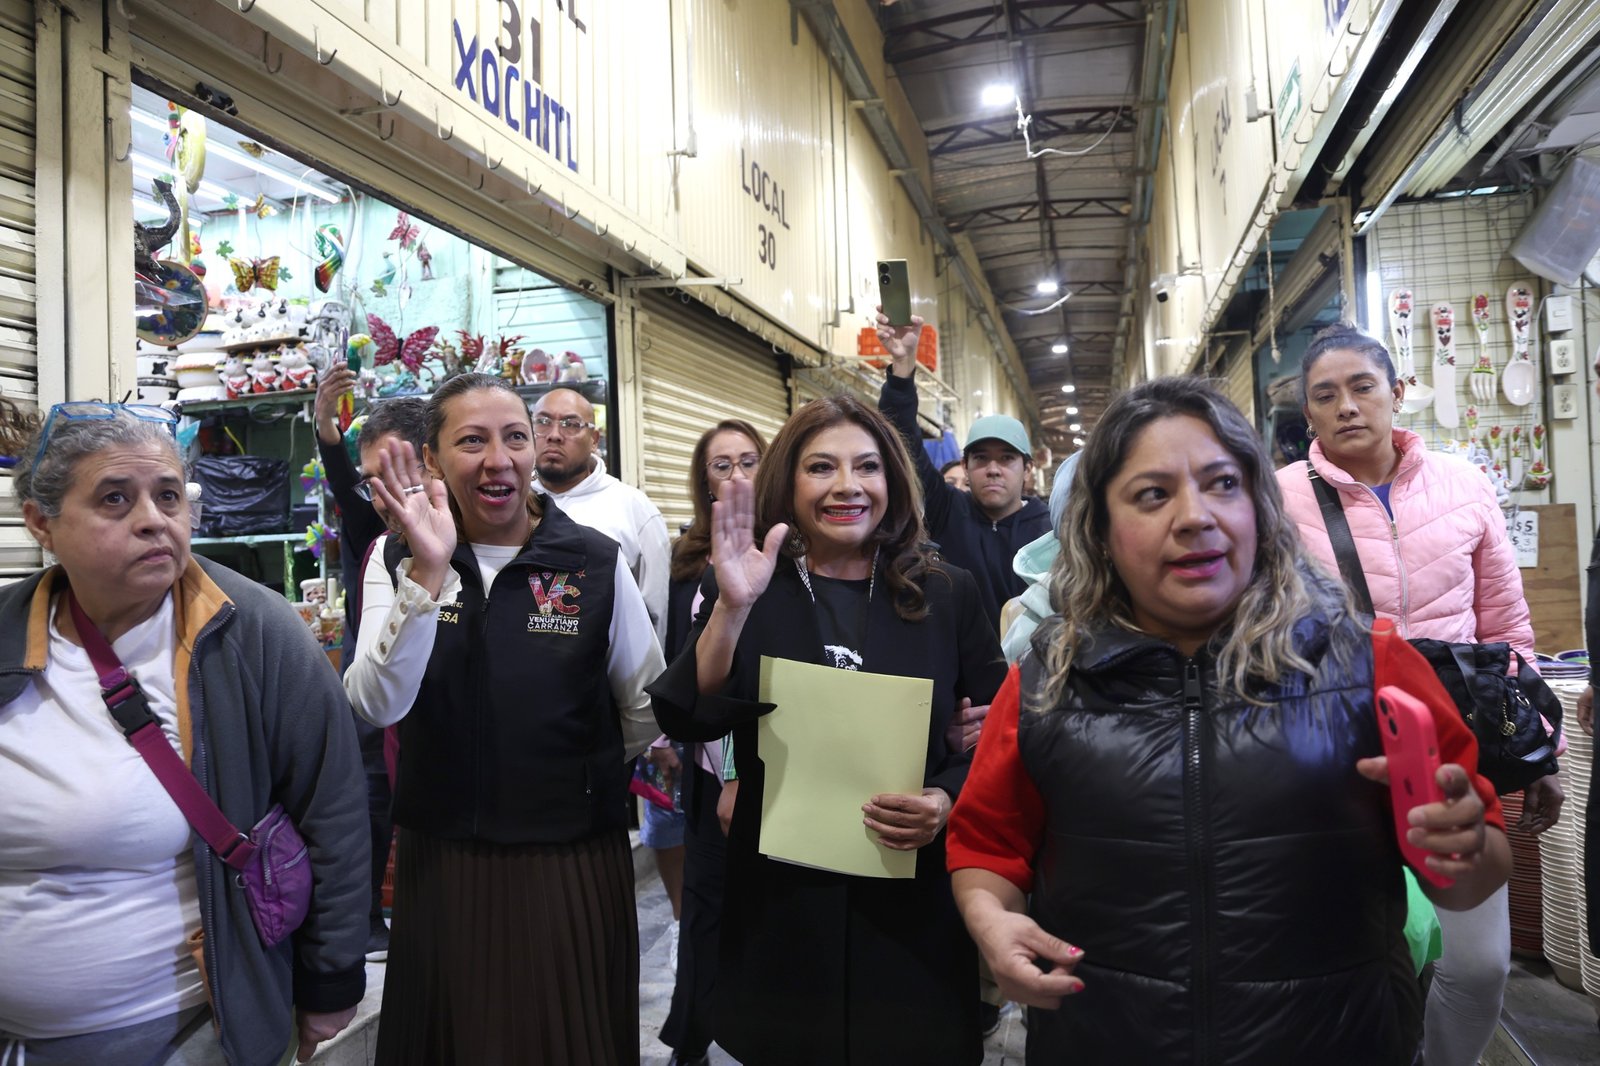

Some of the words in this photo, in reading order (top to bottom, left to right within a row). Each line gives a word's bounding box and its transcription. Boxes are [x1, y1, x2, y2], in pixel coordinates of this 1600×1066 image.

[495, 0, 541, 85] 31
[453, 18, 579, 173] XOCHITL
[741, 148, 790, 230] LOCAL
[758, 223, 777, 271] 30
[527, 622, 579, 632] CARRANZA
[528, 615, 579, 626] VENUSTIANO
